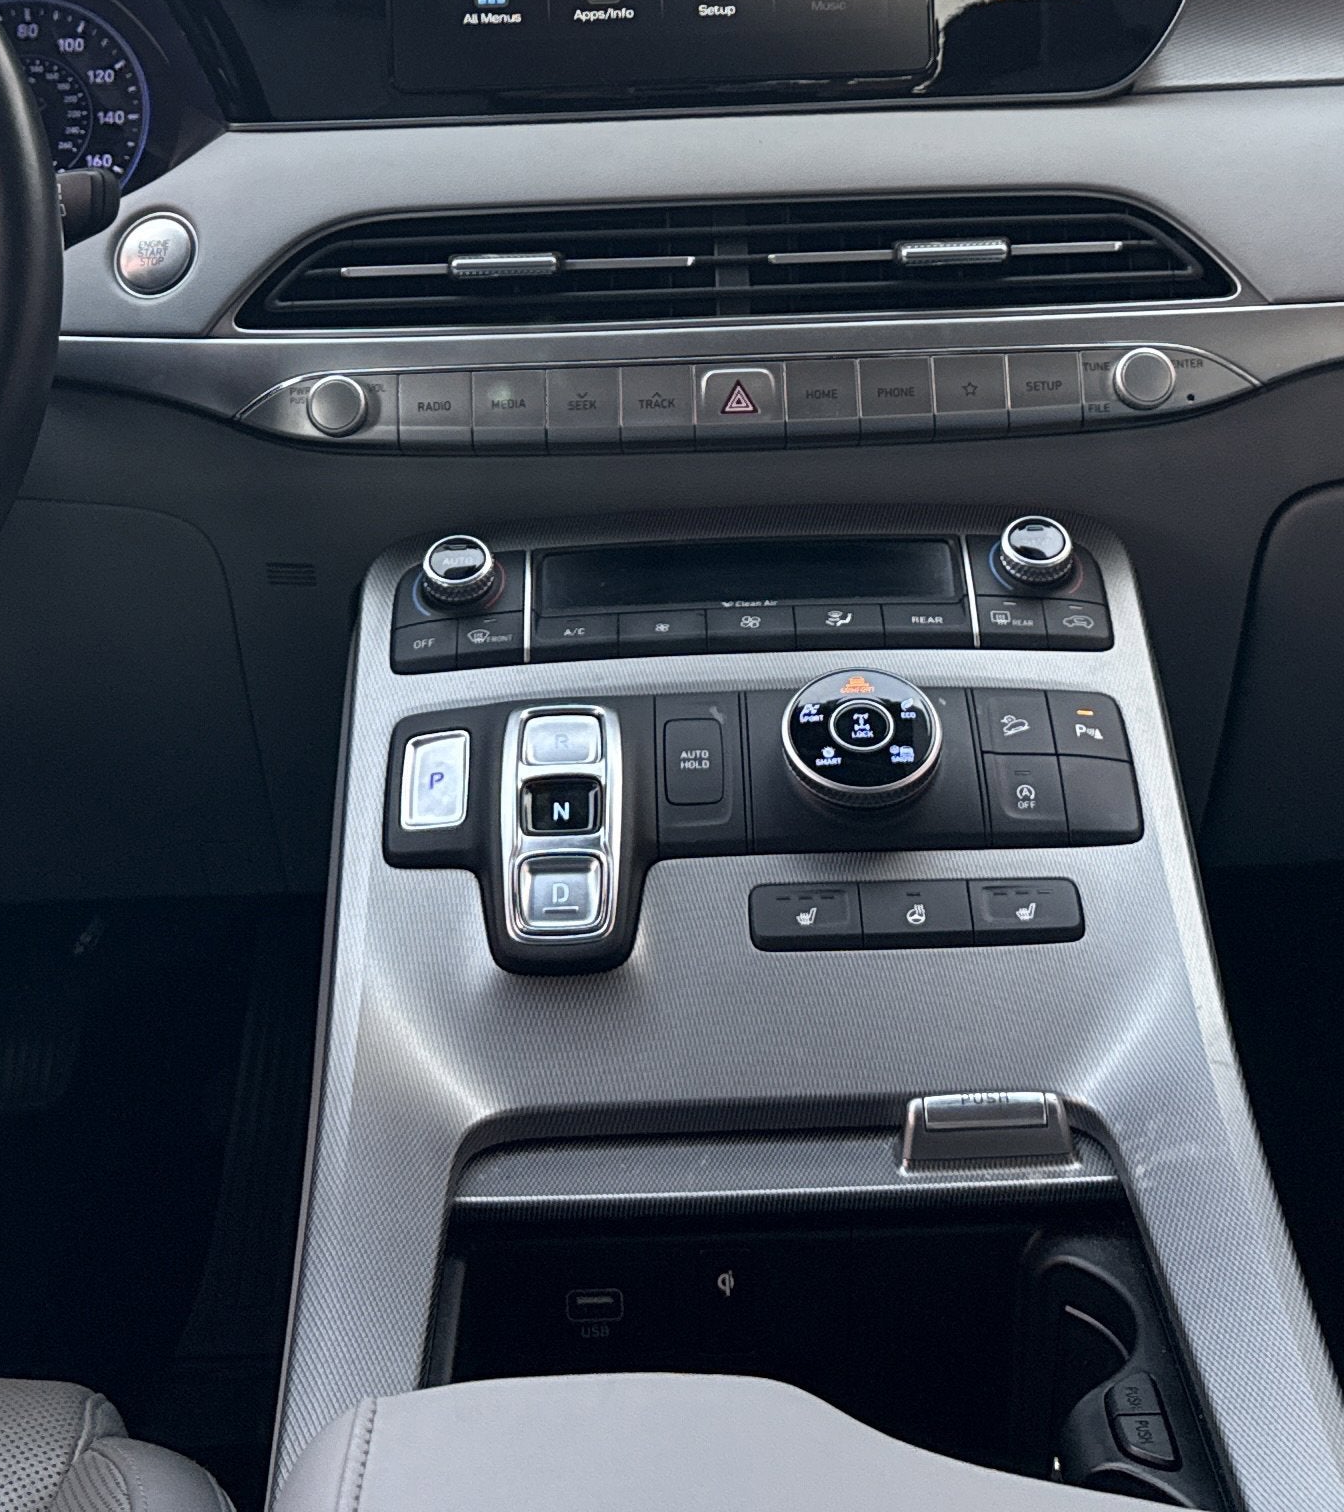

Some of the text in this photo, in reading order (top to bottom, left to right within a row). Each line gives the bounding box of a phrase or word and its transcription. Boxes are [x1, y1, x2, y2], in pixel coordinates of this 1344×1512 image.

[573, 7, 635, 23] Apps/Info
[697, 4, 736, 17] Setup
[463, 12, 522, 25] All Menus
[16, 22, 40, 39] 80
[57, 37, 85, 53] 100
[86, 69, 116, 84] 120
[96, 110, 126, 126] 140
[84, 153, 113, 169] 160
[137, 247, 169, 258] START
[139, 256, 166, 267] STOP
[1083, 361, 1111, 372] TUNE
[1171, 358, 1204, 369] ENTER
[876, 386, 916, 399] PHONE
[1024, 379, 1064, 393] SETUP
[805, 388, 840, 400] HOME
[289, 396, 307, 406] PUS
[416, 400, 453, 414] RADIO
[490, 398, 527, 410] MEDIA
[567, 398, 598, 412] SEEK
[638, 398, 677, 411] TRACK
[1087, 403, 1112, 413] FILE
[734, 598, 778, 609] Clean Air
[911, 615, 944, 625] REAR
[563, 626, 586, 637] A/C
[413, 637, 436, 650] OFF
[900, 710, 917, 720] ECO
[851, 730, 874, 739] LOCK
[679, 748, 710, 760] AUTO
[679, 759, 711, 771] HOLD
[815, 756, 843, 767] SMART
[428, 771, 446, 790] P
[552, 800, 571, 823] N
[1017, 800, 1036, 810] OFF
[552, 881, 571, 904] D
[960, 1091, 1011, 1106] PUSH
[580, 1324, 611, 1339] USB
